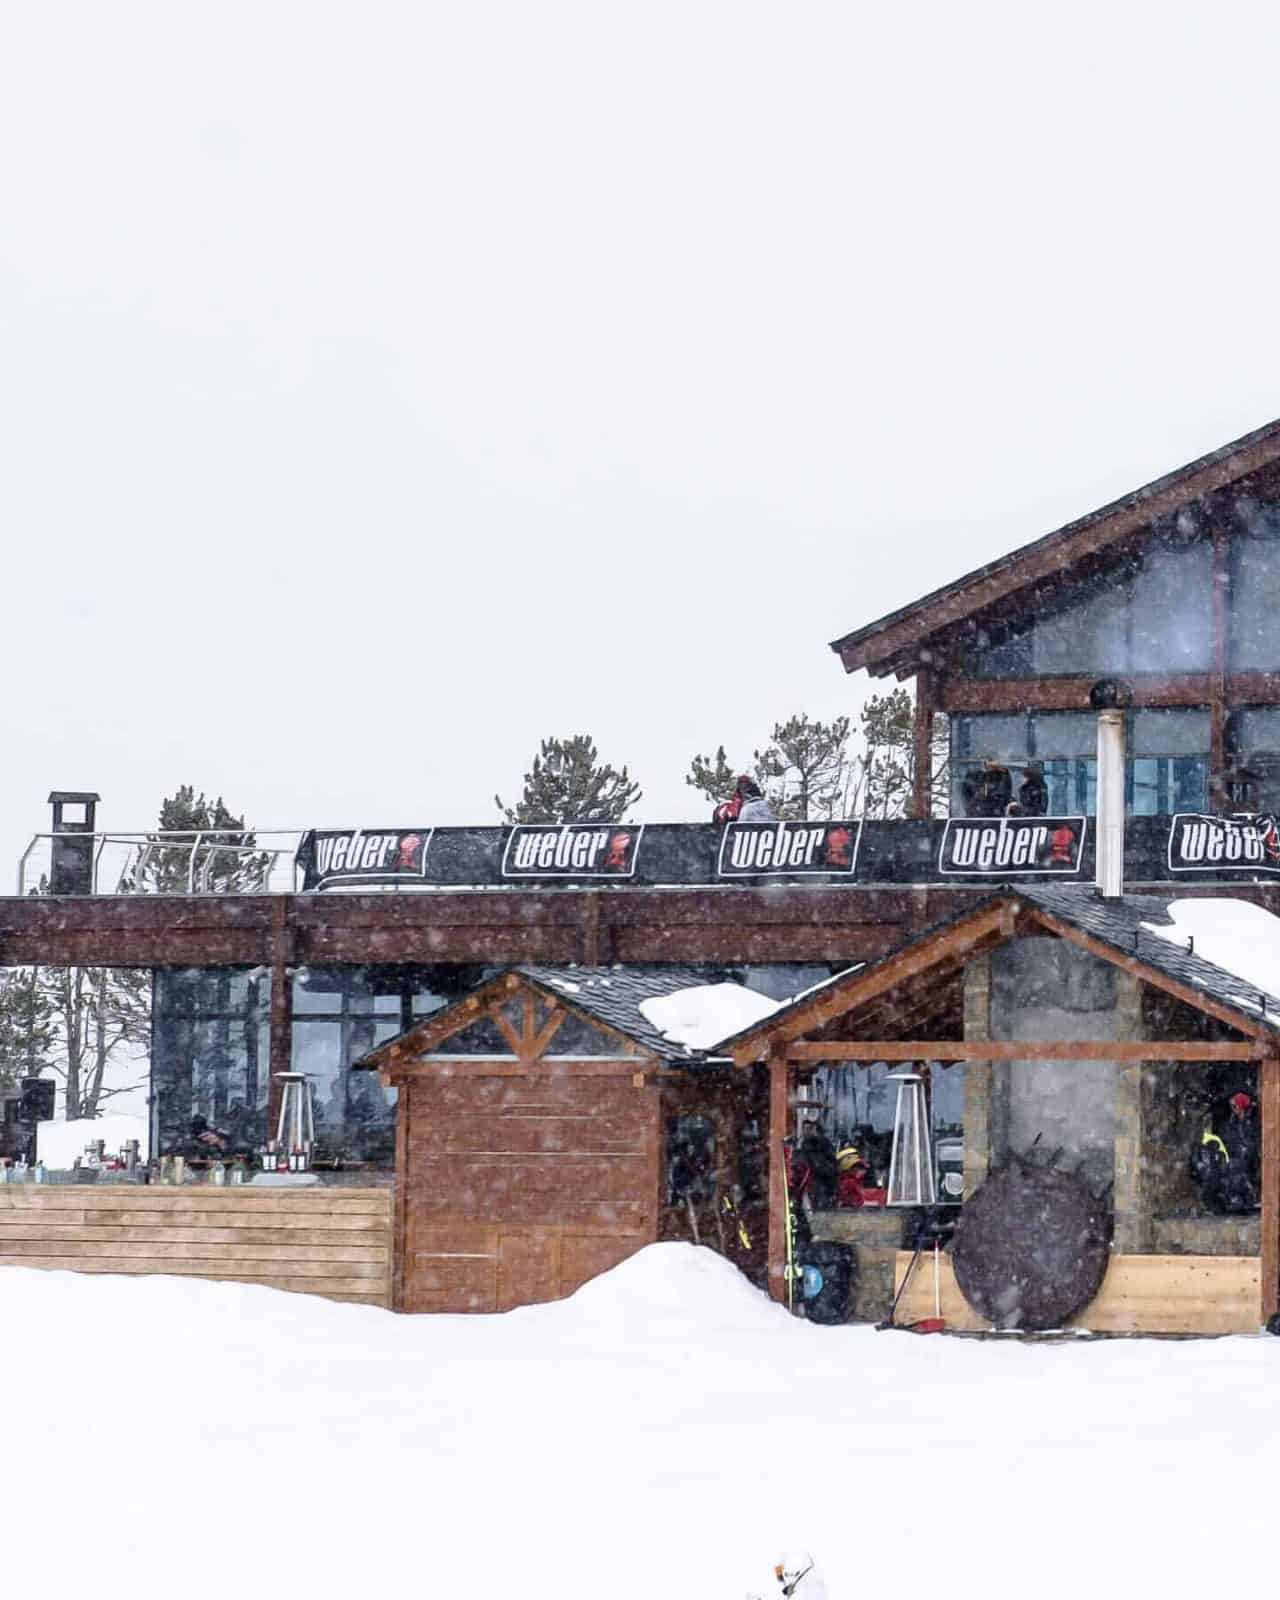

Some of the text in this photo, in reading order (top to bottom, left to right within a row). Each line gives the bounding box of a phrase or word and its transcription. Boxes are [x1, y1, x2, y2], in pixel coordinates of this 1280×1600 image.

[316, 828, 399, 875] weber
[514, 826, 606, 868] weber
[730, 820, 825, 868] weber
[951, 817, 1048, 867] weber
